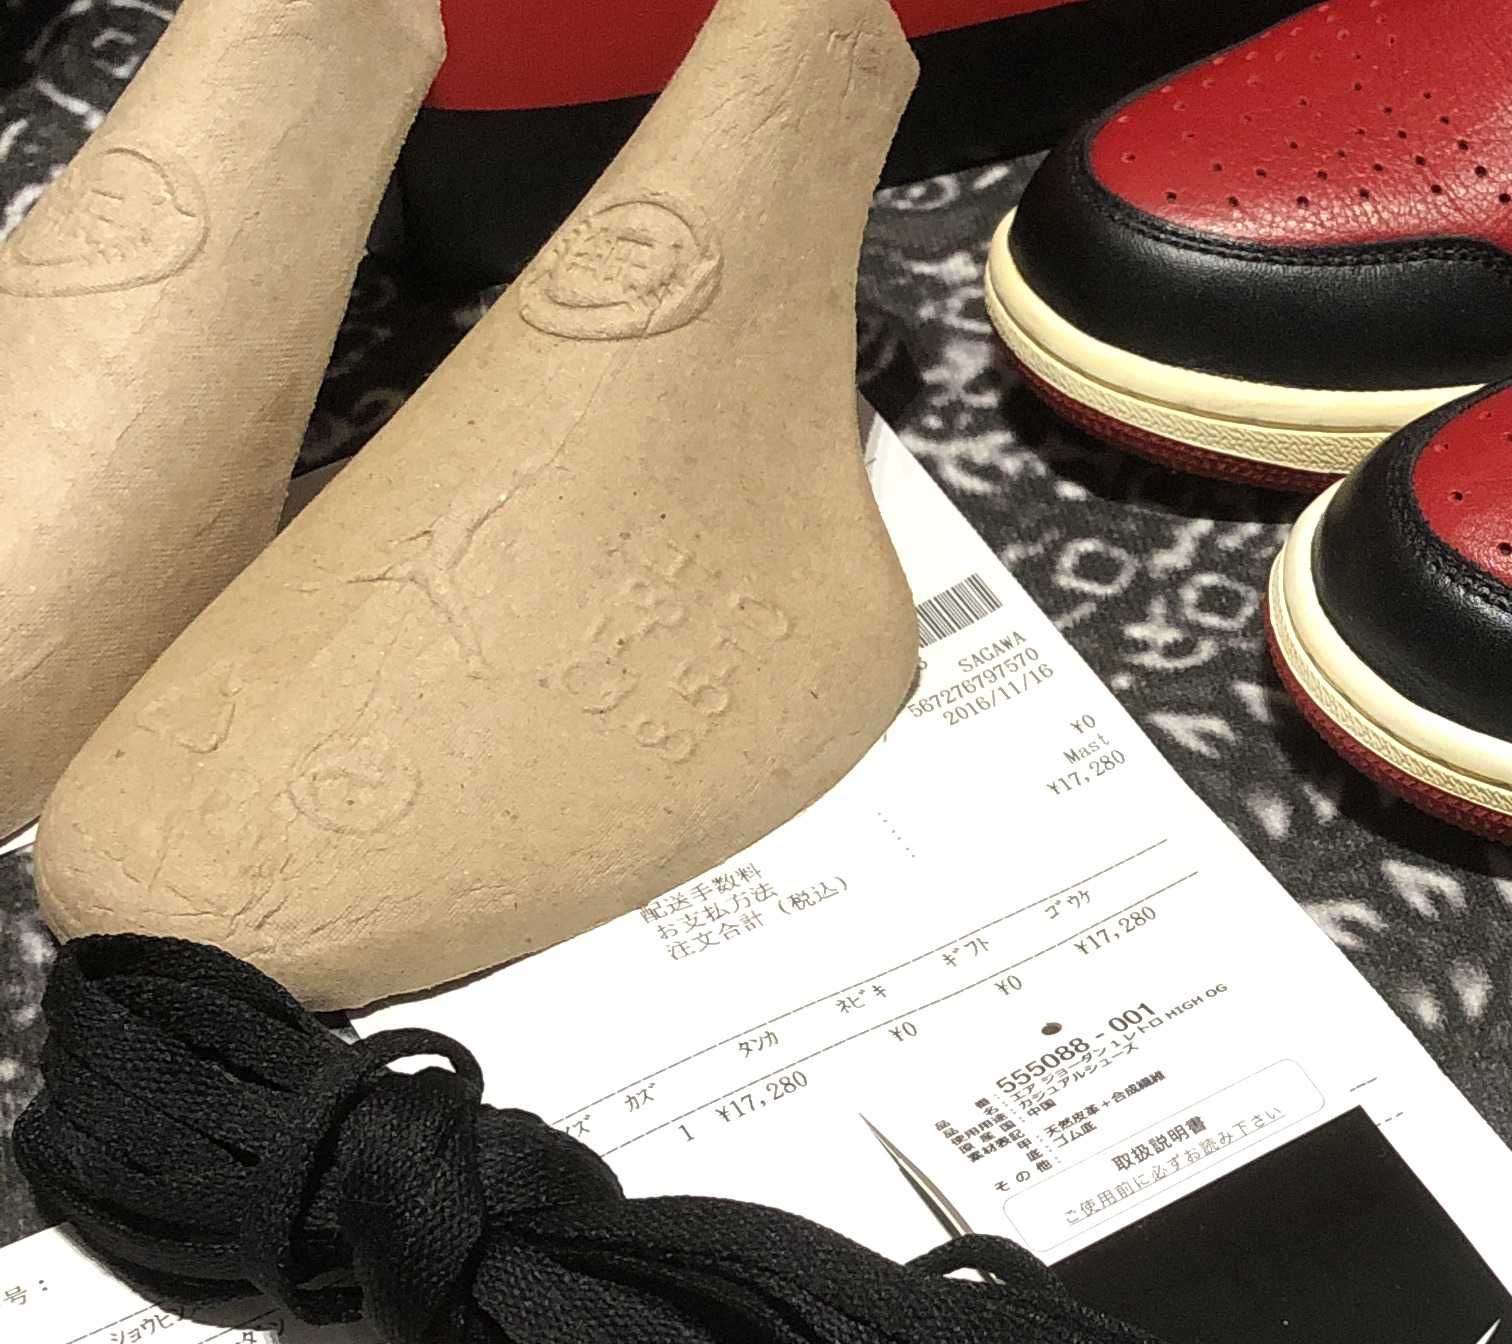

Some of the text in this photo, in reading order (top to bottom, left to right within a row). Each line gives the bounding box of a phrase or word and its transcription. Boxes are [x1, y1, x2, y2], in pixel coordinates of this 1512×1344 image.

[957, 631, 1027, 674] SAGAWA
[907, 647, 1039, 718] 567276797570
[943, 663, 1054, 726] 2016/11/16
[1046, 749, 1126, 795] ¥17,280
[1063, 733, 1110, 764] Mast
[640, 862, 763, 924] 配送手数料
[657, 882, 778, 939] お支払方法
[678, 905, 1157, 1142] 1 ¥17,280 ¥0 ¥0 ¥17,280
[1165, 995, 1204, 1020] HIGH
[1205, 983, 1228, 998] OG
[1027, 1098, 1056, 1117] 中国
[1111, 1115, 1208, 1172] 取扱説明書
